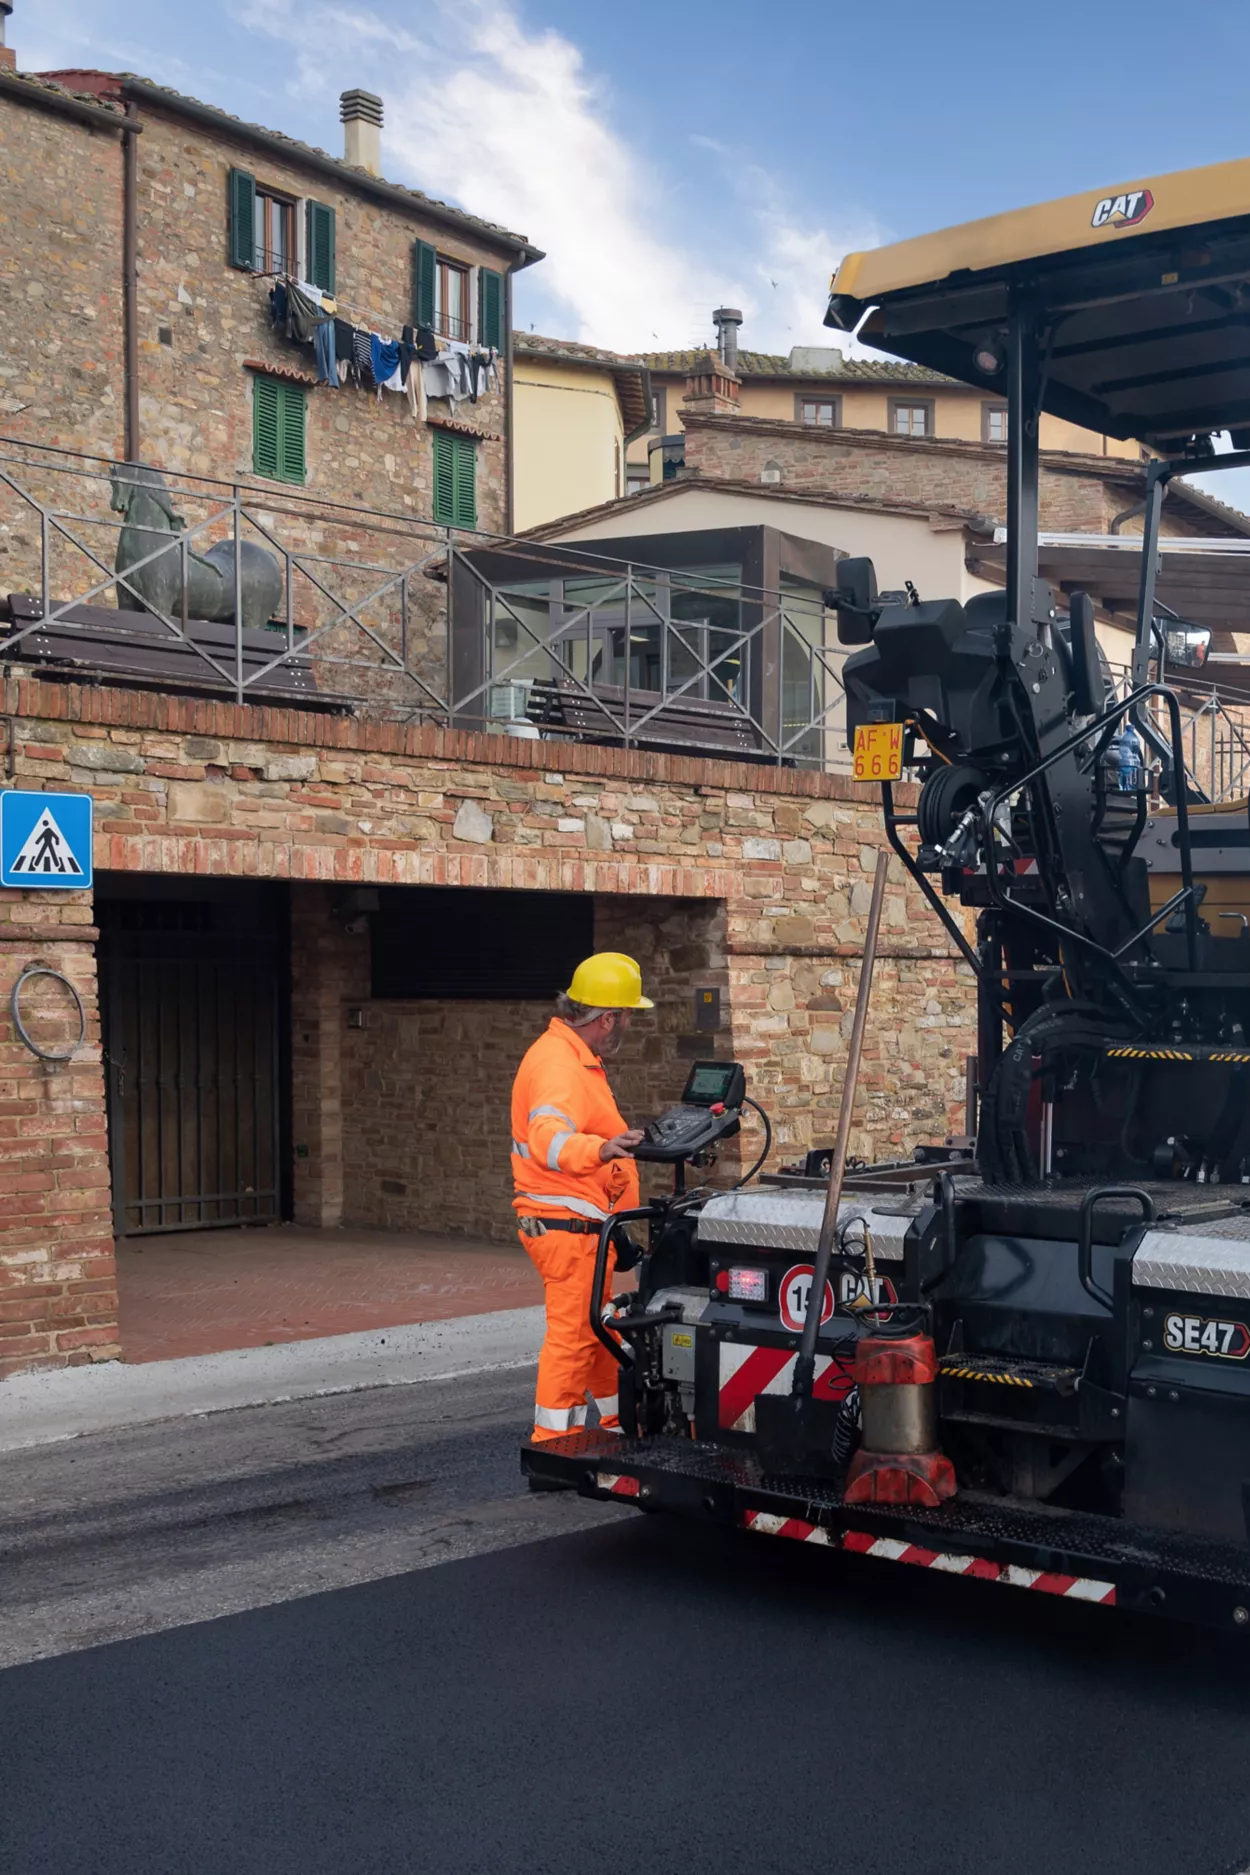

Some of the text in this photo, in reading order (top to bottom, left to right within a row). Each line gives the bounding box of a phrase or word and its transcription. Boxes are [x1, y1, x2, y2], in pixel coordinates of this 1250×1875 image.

[1092, 190, 1144, 228] CAT
[856, 728, 900, 752] AF W
[855, 753, 898, 776] 666
[1166, 1315, 1235, 1354] SE47
